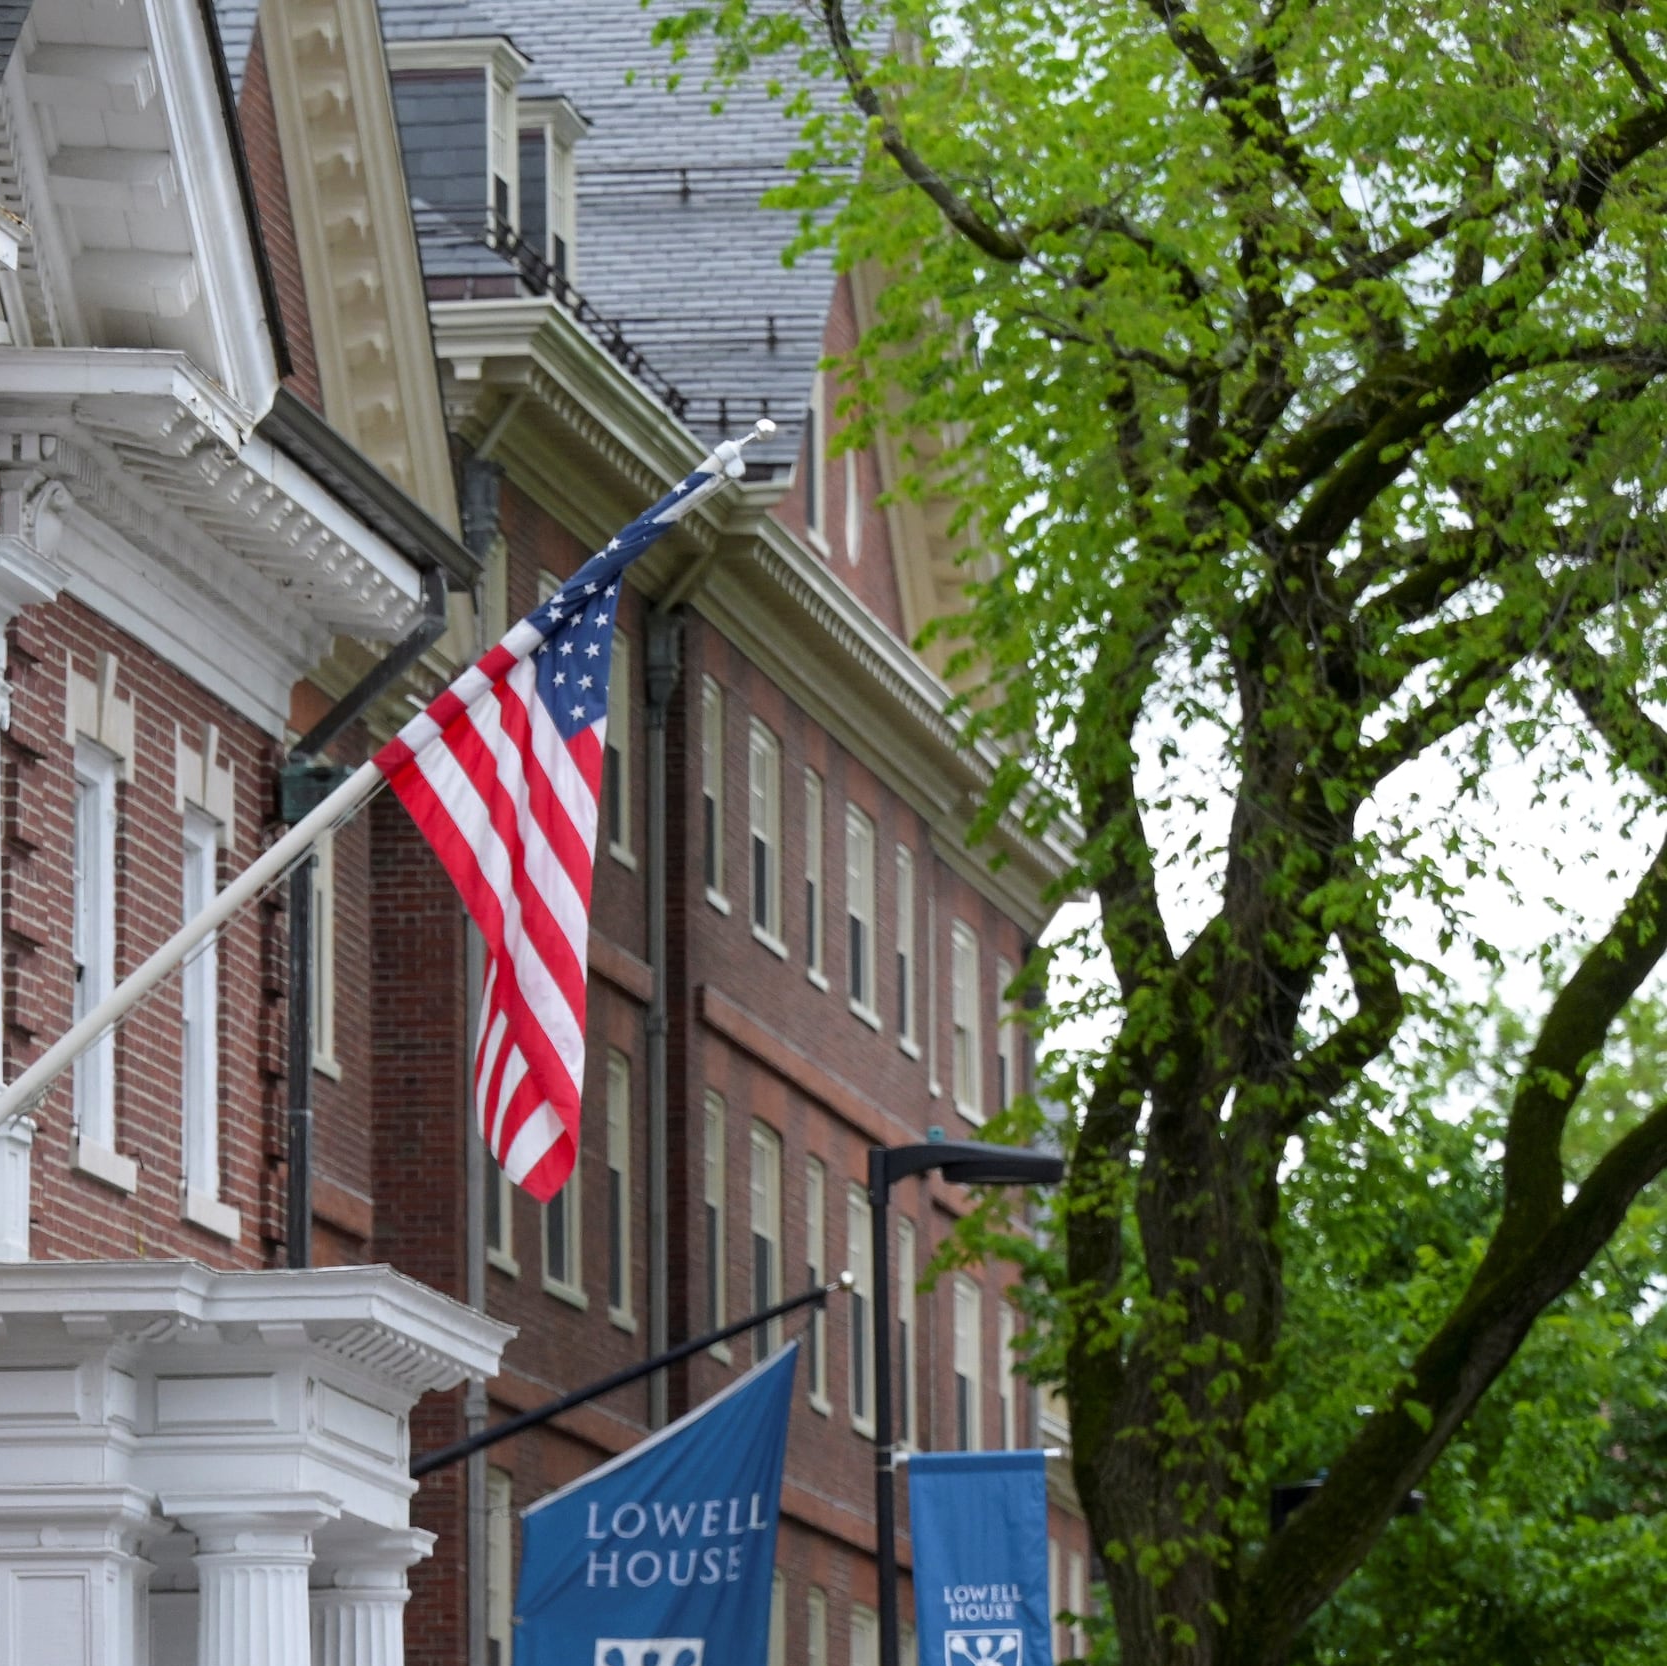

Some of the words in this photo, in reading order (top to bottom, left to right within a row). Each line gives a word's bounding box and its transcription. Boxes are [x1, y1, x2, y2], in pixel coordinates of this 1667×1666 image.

[585, 1493, 768, 1540] LOWELL
[585, 1546, 744, 1588] HOUSE
[943, 1583, 1022, 1604] LOWELL
[949, 1602, 1016, 1622] HOUSE
